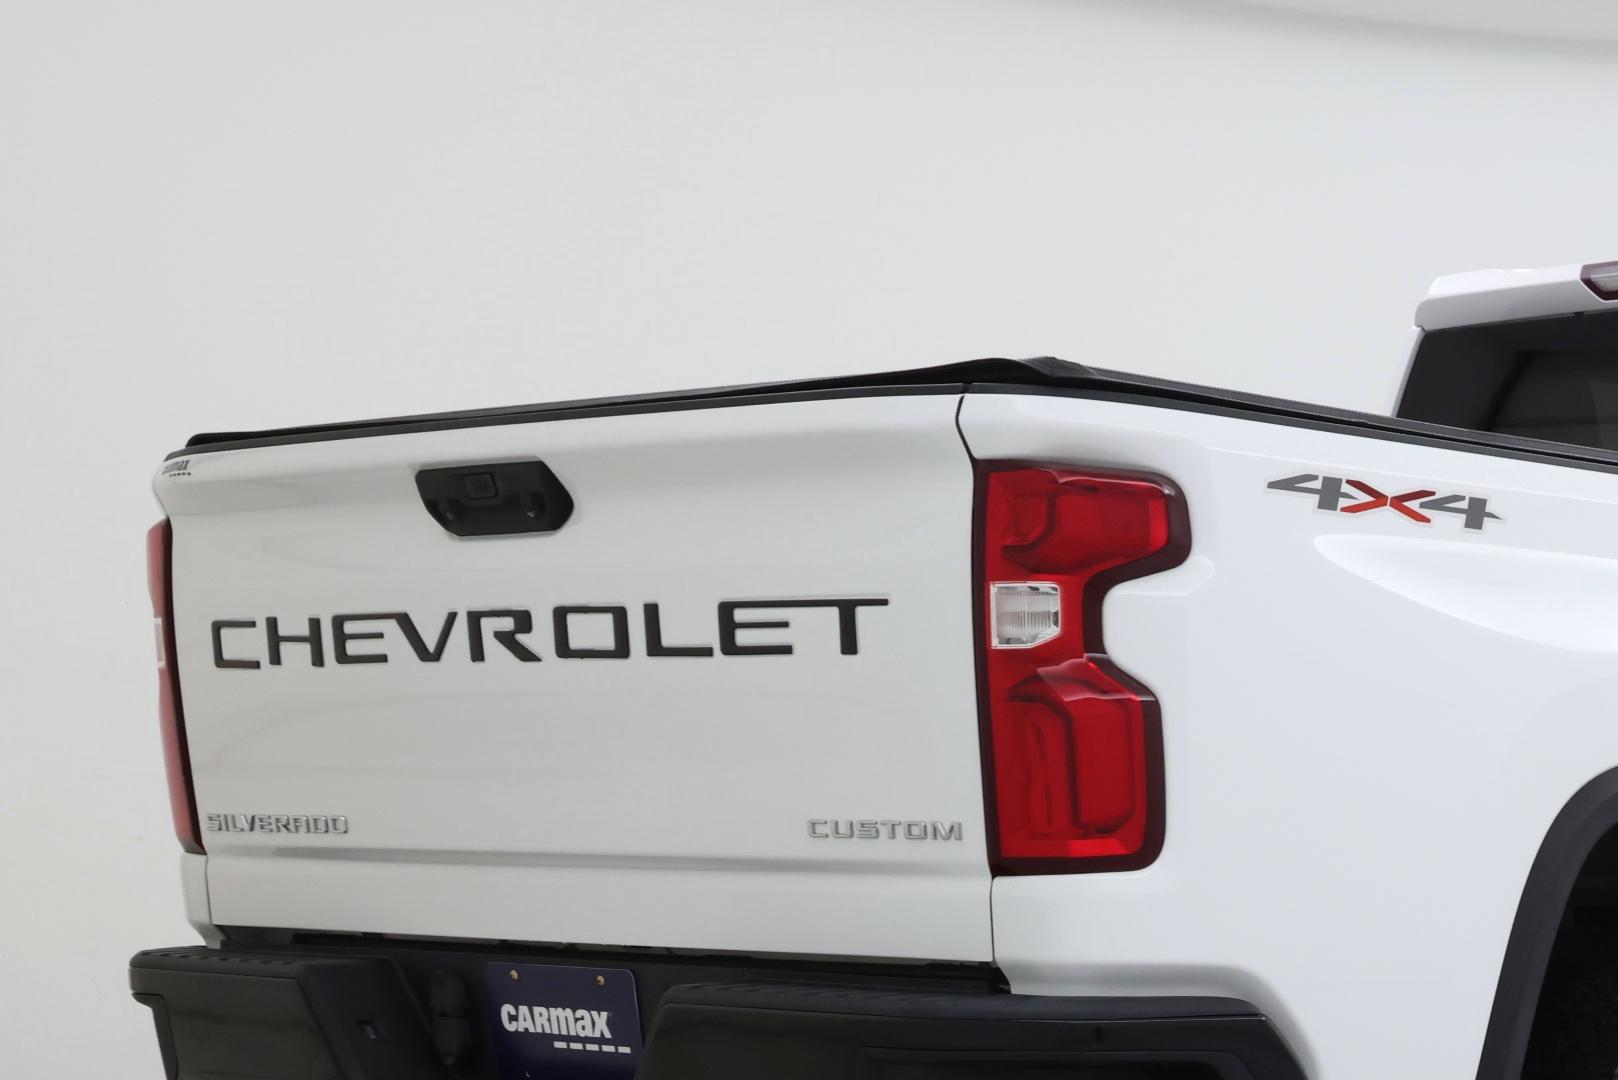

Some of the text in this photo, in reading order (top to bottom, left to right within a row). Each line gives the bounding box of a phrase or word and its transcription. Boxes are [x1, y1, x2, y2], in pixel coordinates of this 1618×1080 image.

[211, 598, 890, 669] CHEVROLET
[206, 813, 349, 834] SILVERADO
[806, 818, 963, 841] CUSTOM
